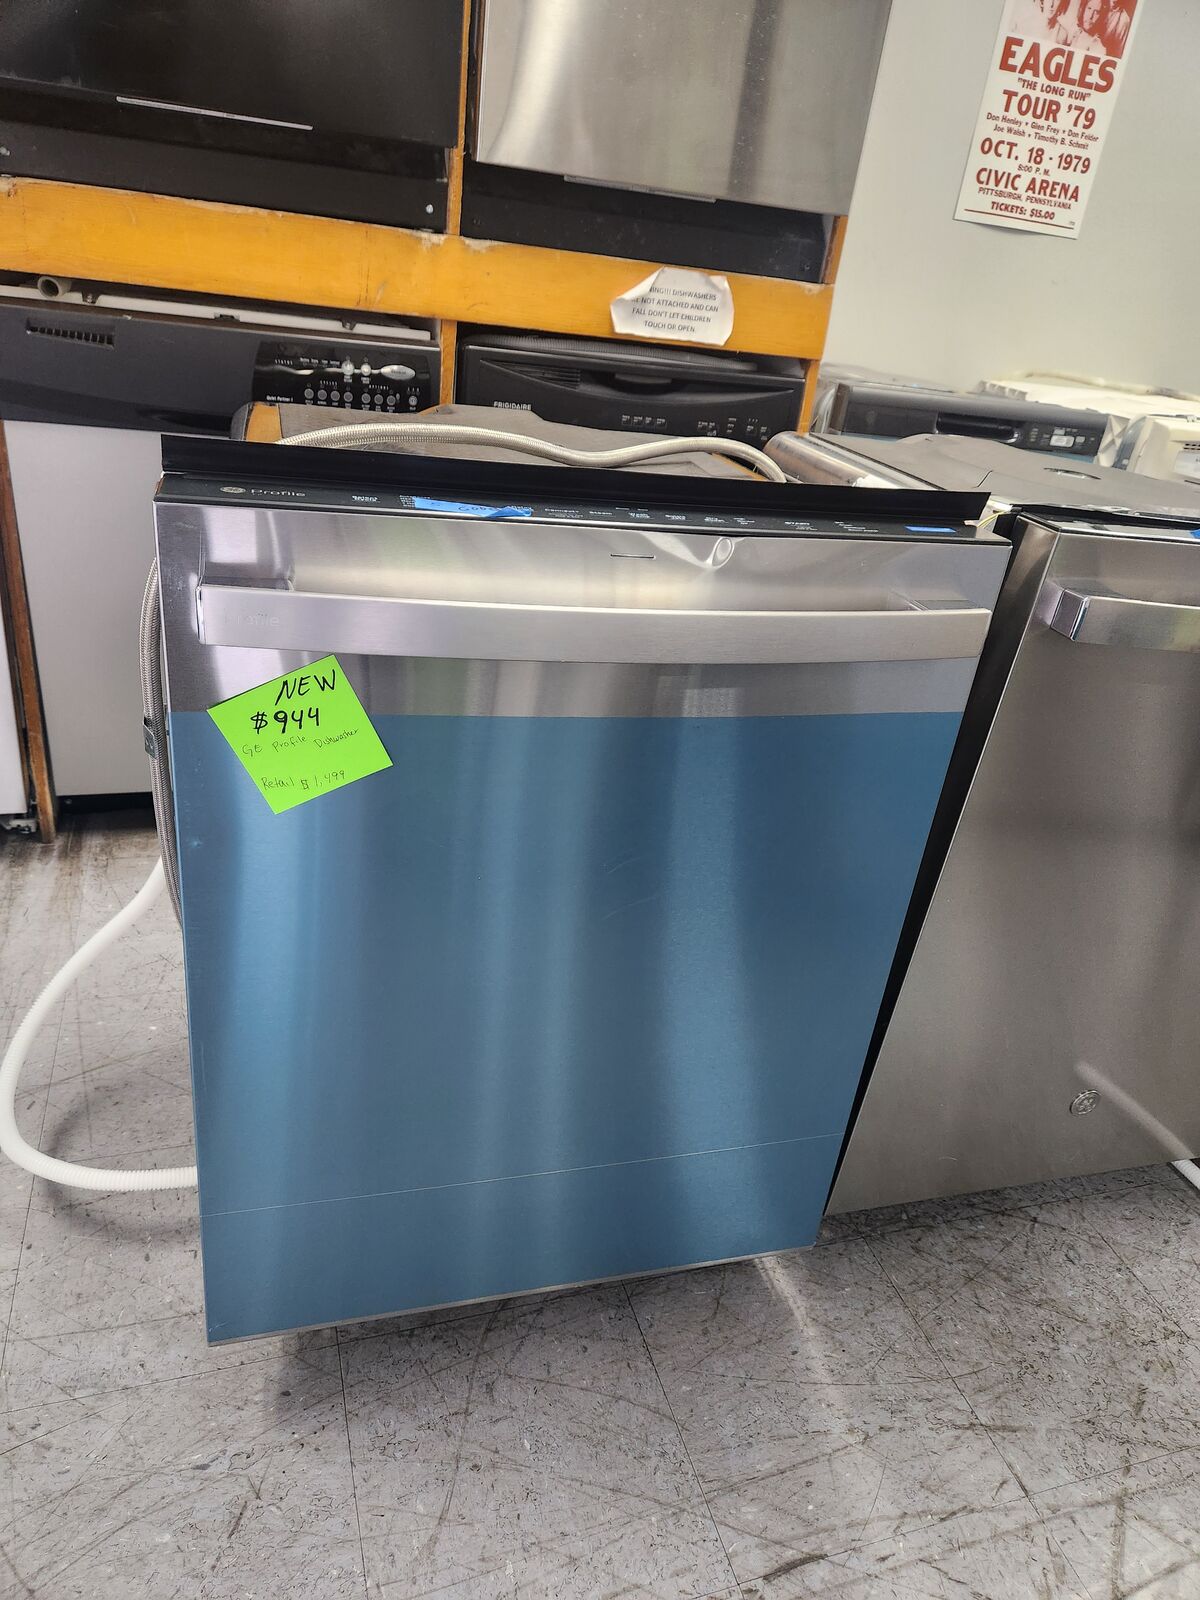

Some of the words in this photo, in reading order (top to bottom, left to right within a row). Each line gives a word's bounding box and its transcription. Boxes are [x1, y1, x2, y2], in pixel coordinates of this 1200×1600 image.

[999, 36, 1118, 93] EAGLES
[1017, 77, 1037, 90] "THE
[1040, 83, 1065, 97] LONG
[1068, 90, 1091, 102] RUN"
[1002, 90, 1061, 123] TOUR
[1067, 104, 1096, 130] '79
[986, 112, 1000, 121] Don
[1001, 114, 1022, 127] Henley
[1030, 121, 1045, 131] Glen
[1046, 125, 1060, 135] Frey
[1067, 129, 1080, 138] Don
[1080, 133, 1099, 142] Felder
[993, 124, 1005, 133] Joe
[1007, 127, 1026, 138] Walsh
[1034, 132, 1059, 145] Timothy
[1060, 138, 1067, 146] B.
[980, 137, 1019, 161] OCT.
[1027, 147, 1045, 165] 18
[1057, 153, 1091, 174] 1979
[976, 167, 1022, 191] CIVIC
[1025, 177, 1080, 202] ARENA
[990, 201, 1027, 215] TICKETS:
[1030, 208, 1056, 220] $15.00
[1025, 195, 1072, 210] PENNSYLVANIA
[656, 299, 689, 309] ATTACHED
[690, 303, 705, 311] AND
[705, 305, 719, 313] CAN
[672, 289, 717, 301] DISHWASHERS
[632, 308, 646, 316] FALL
[648, 309, 668, 318] DON'T
[669, 312, 680, 320] LET
[680, 313, 711, 323] CHILDREN
[644, 320, 666, 329] TOUCH
[667, 322, 676, 330] OR
[677, 324, 695, 332] OPEN
[493, 401, 532, 410] FRIGIDAIRE
[251, 489, 306, 497] Profile
[275, 669, 336, 706] NEW
[250, 707, 320, 735] $944
[242, 744, 263, 757] GE
[271, 735, 308, 753] Profile
[313, 728, 359, 749] Dishwasher
[261, 776, 295, 790] Retail
